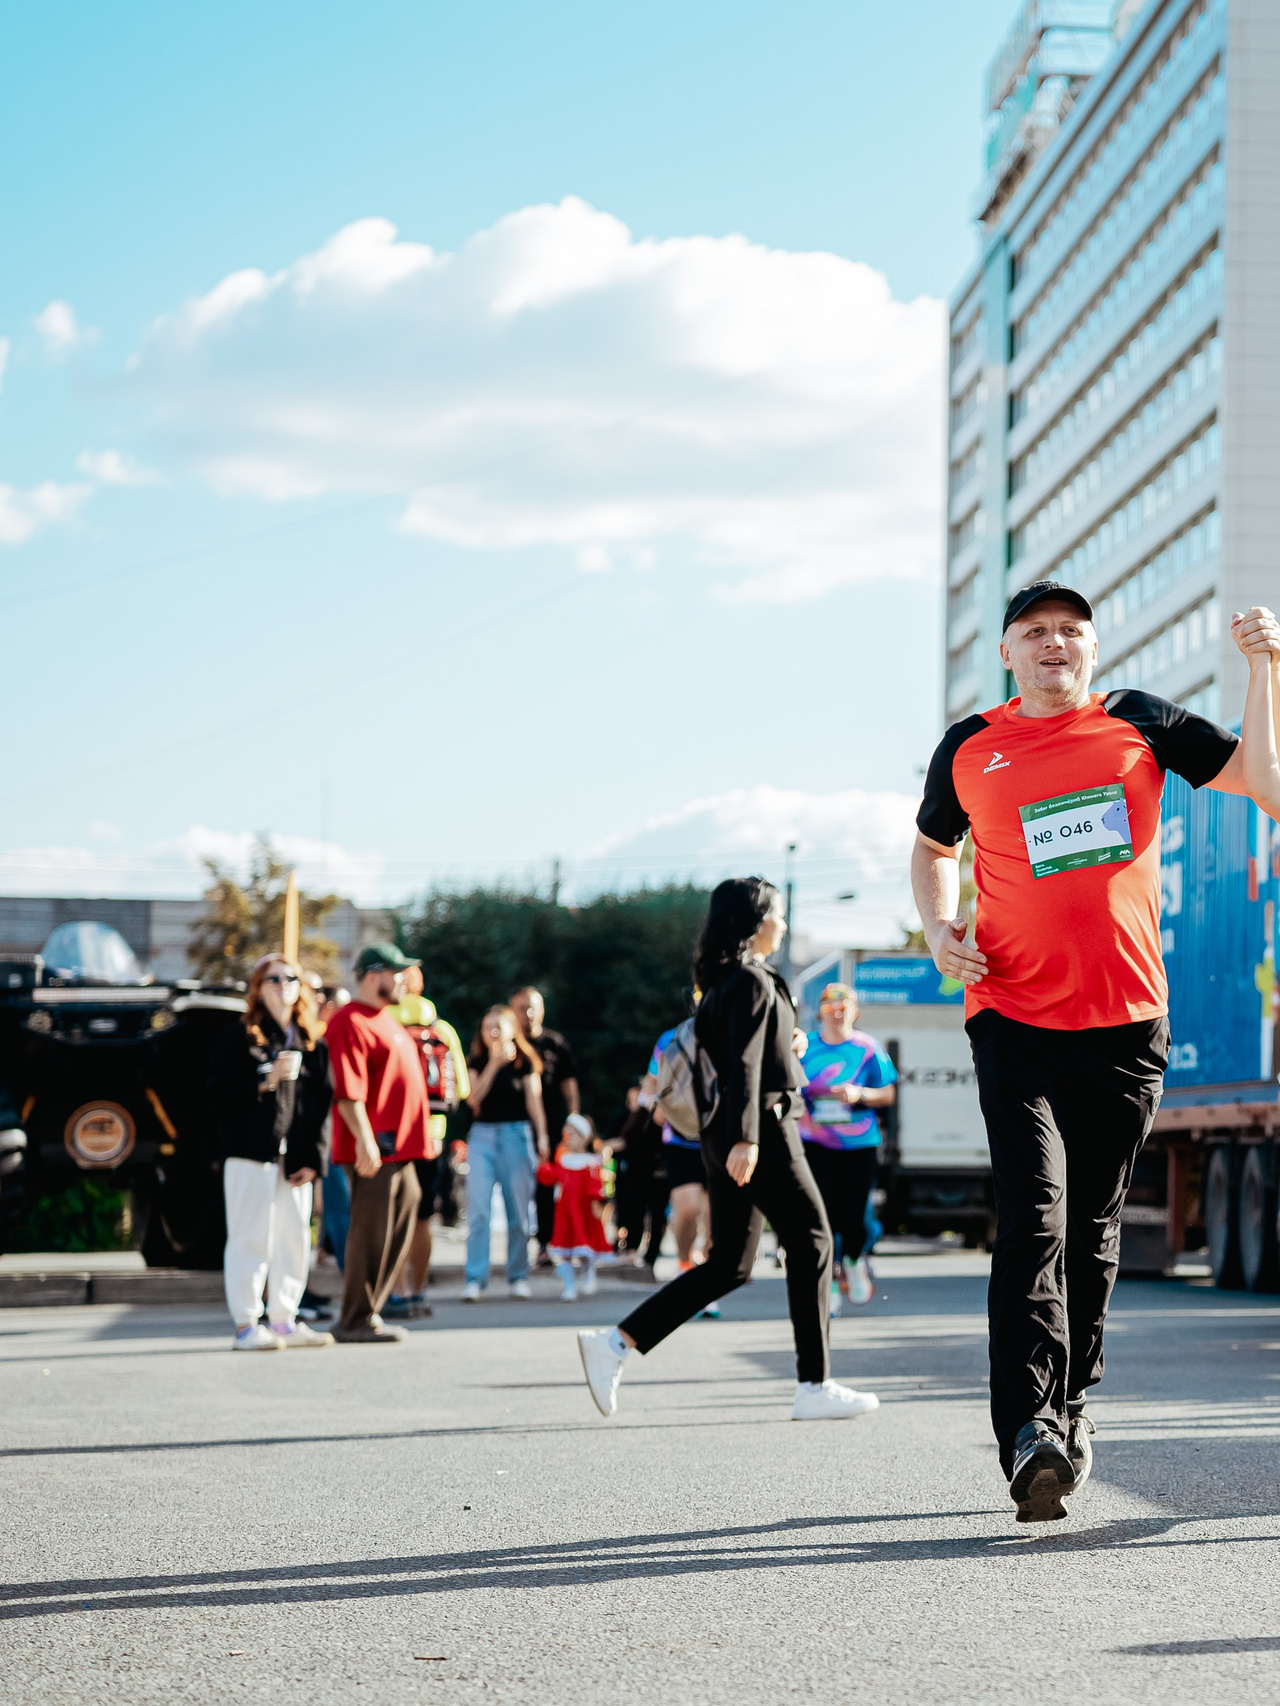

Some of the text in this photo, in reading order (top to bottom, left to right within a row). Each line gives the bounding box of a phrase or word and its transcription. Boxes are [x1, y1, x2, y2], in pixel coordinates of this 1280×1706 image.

[983, 760, 1011, 774] DEMIX
[1033, 820, 1093, 846] № 046
